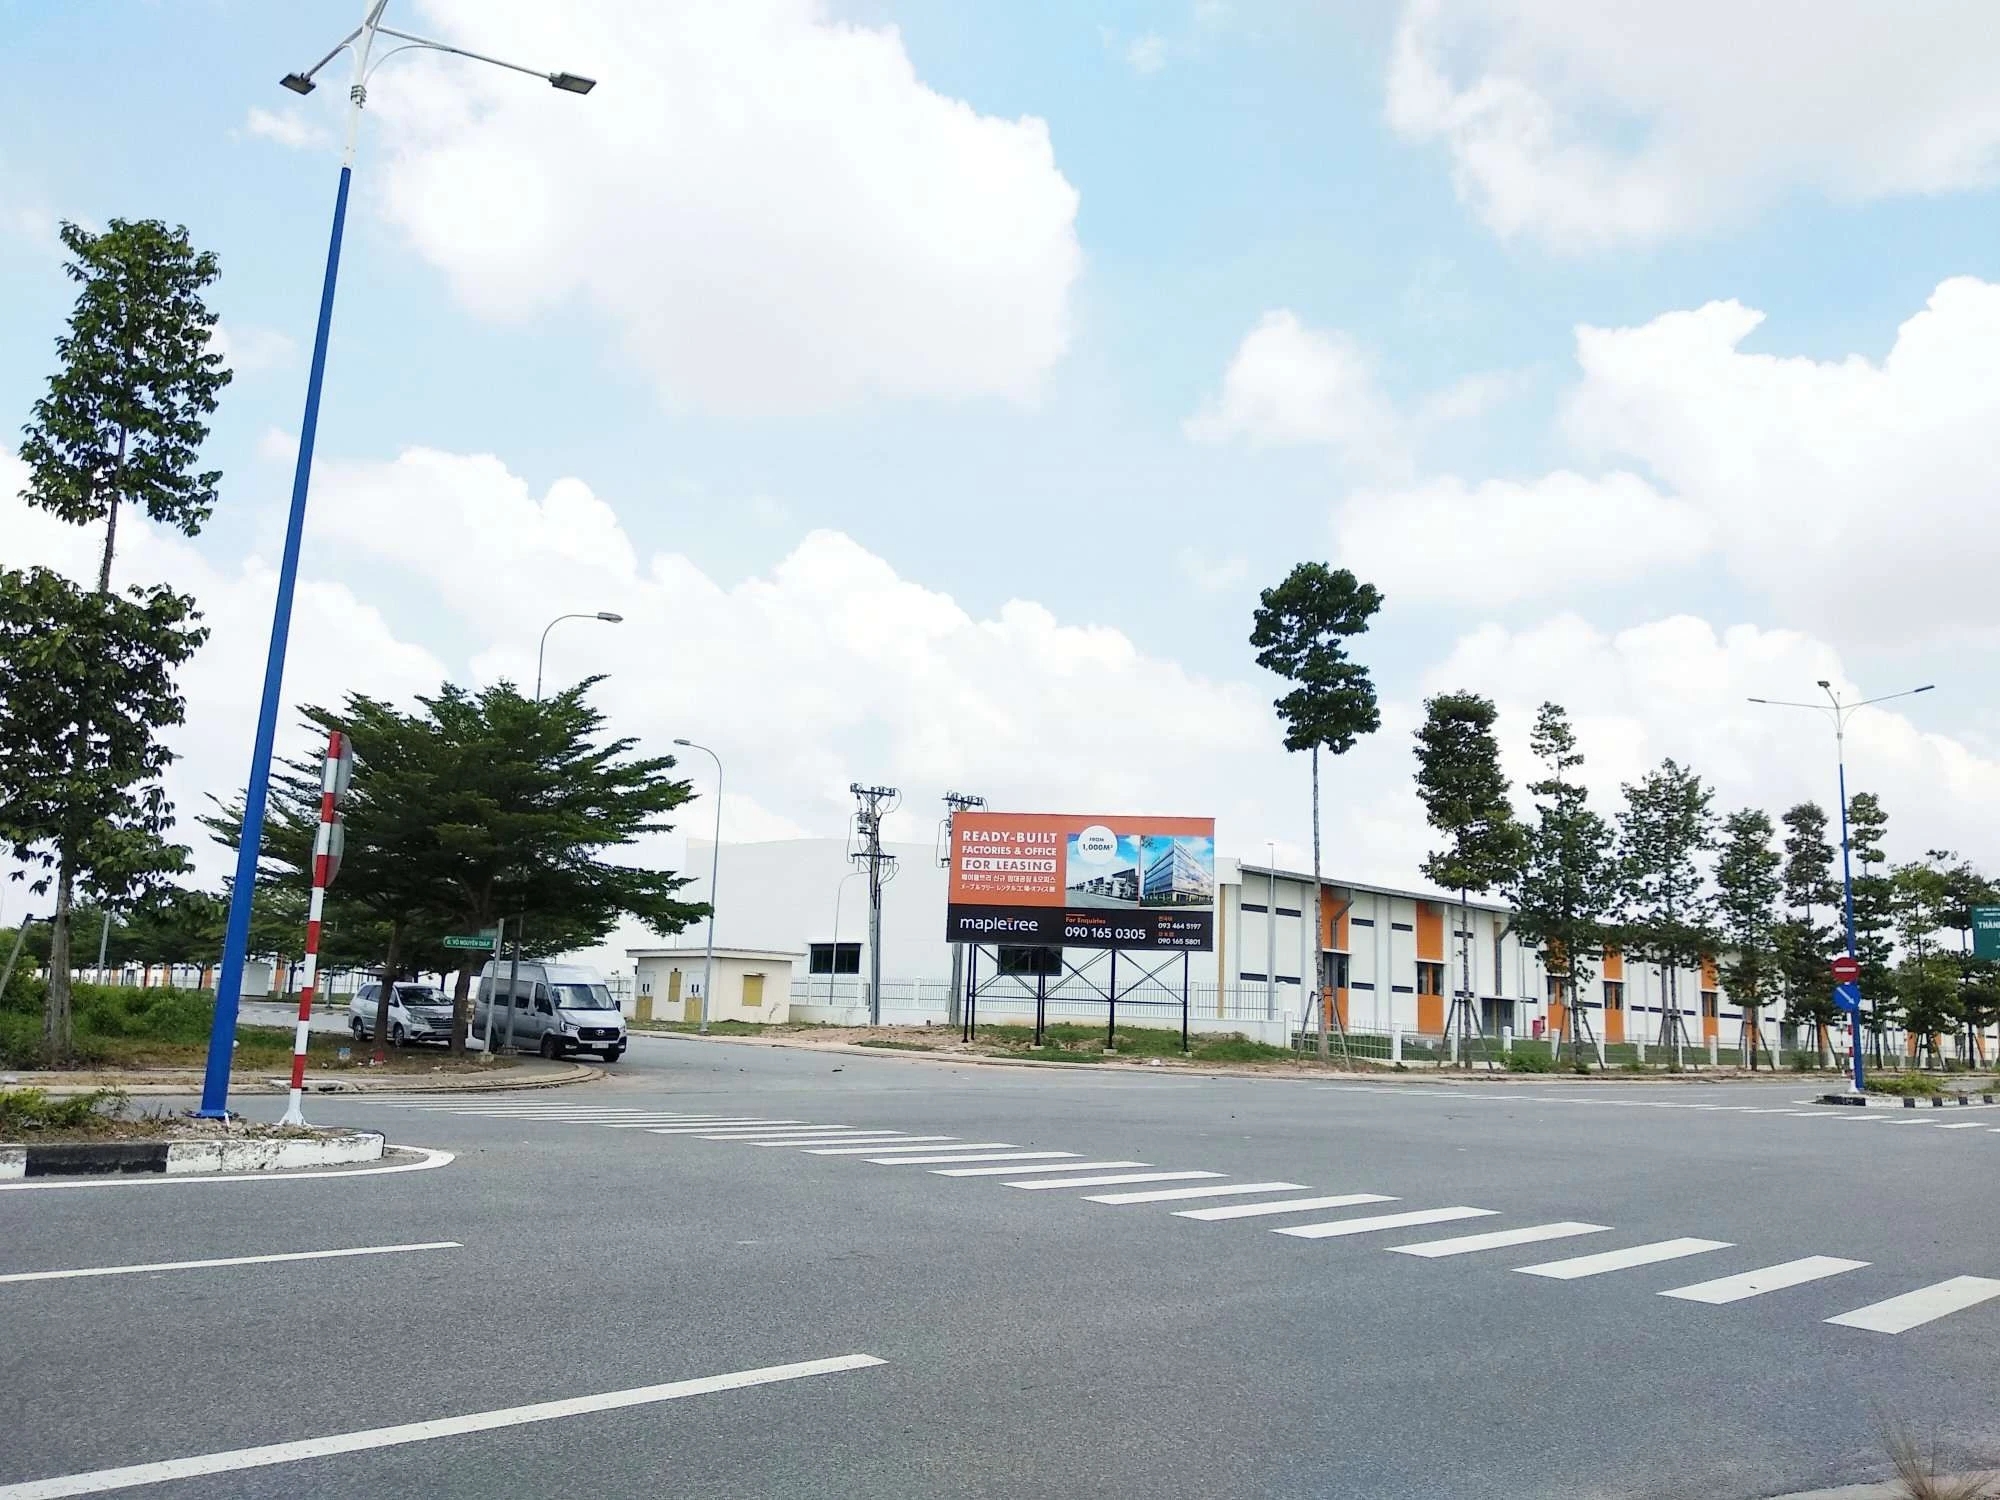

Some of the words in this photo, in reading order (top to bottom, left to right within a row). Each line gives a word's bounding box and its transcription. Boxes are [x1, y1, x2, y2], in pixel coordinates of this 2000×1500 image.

[962, 831, 1057, 843] READY-BUILT
[961, 845, 1011, 855] FACTORIES
[1014, 847, 1022, 855] &
[1024, 847, 1057, 856] OFFICE
[965, 860, 991, 869] FOR
[997, 861, 1053, 871] LEASING
[960, 917, 1038, 933] mapletree
[1065, 926, 1088, 938] 090
[1090, 927, 1112, 938] 165
[1115, 928, 1146, 939] 0305
